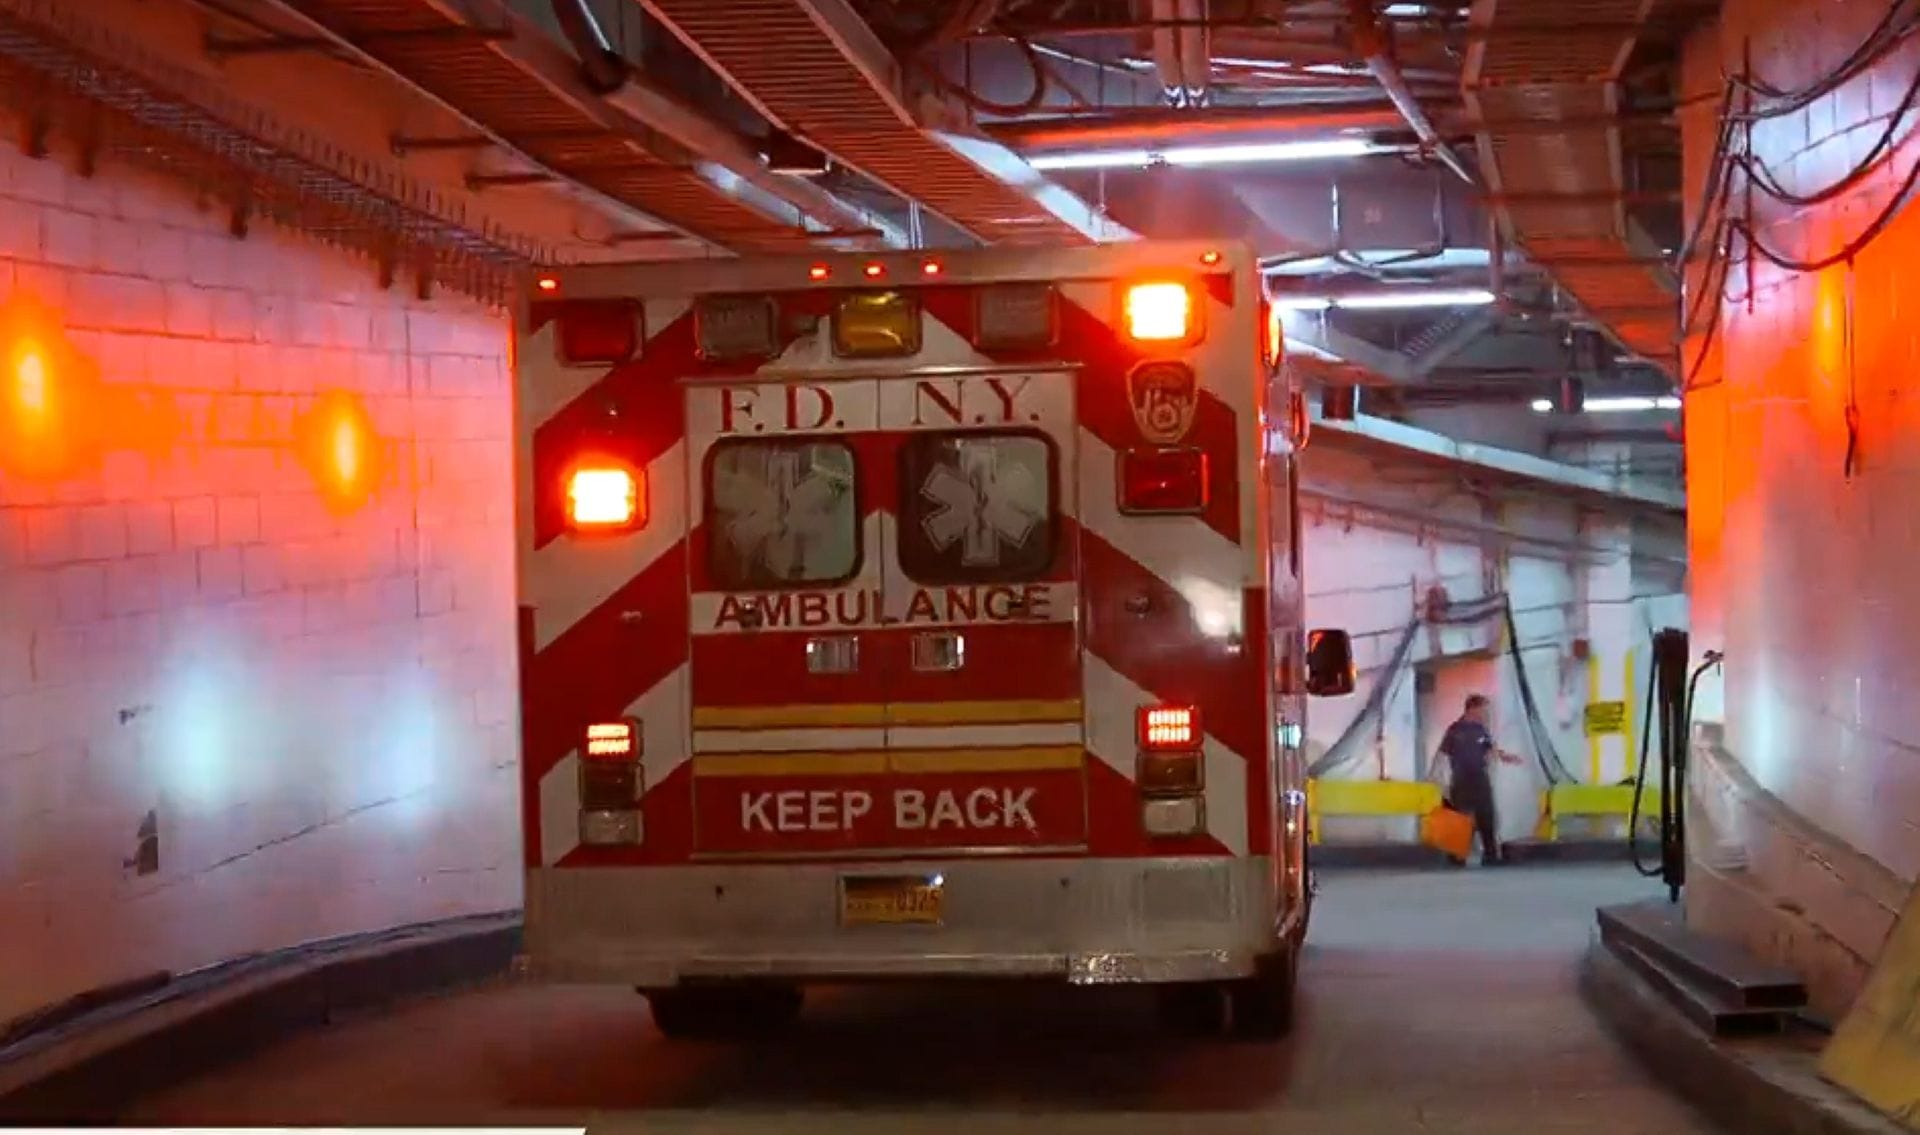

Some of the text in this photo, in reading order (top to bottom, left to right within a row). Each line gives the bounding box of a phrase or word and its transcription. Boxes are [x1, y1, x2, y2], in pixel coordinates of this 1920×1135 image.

[715, 375, 1041, 433] F.D. N.Y.
[714, 587, 1051, 628] AMBULANCE
[741, 787, 1038, 836] KEEP BACK
